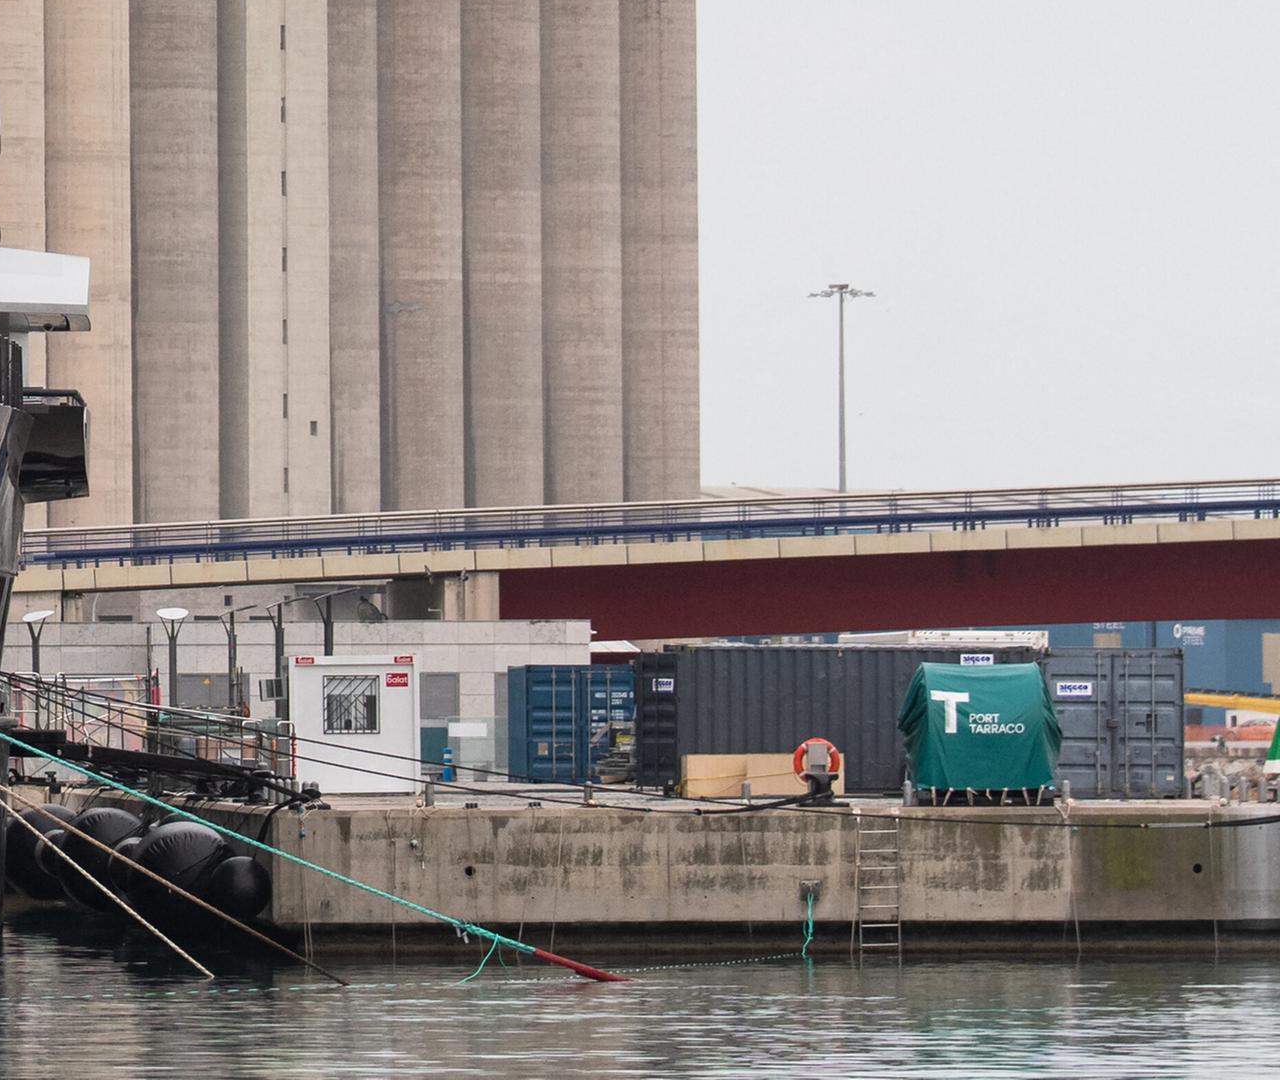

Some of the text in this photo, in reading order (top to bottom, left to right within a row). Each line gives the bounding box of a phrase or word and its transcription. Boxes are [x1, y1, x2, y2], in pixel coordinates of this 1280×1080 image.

[1183, 636, 1205, 645] STEEL
[930, 690, 970, 734] T
[969, 713, 1000, 723] PORT
[969, 724, 1025, 734] TARRACO
